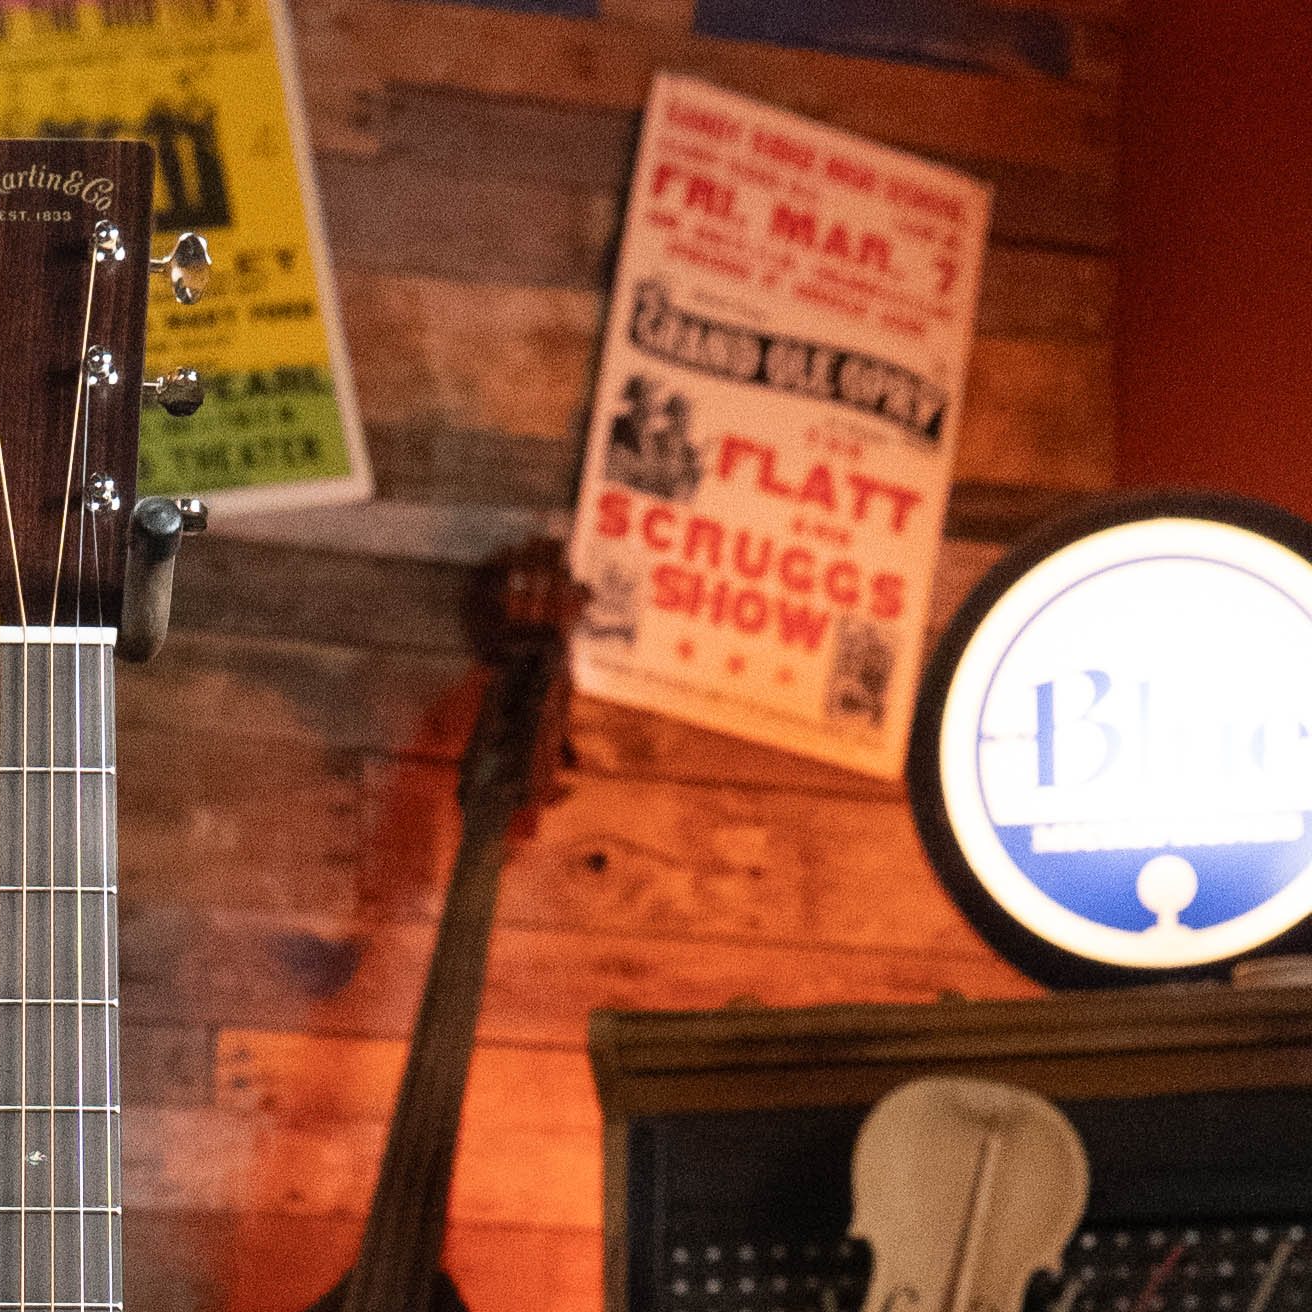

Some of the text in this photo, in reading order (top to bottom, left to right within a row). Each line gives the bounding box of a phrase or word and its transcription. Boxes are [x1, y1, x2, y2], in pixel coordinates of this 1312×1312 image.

[36, 210, 72, 222] 1833
[717, 434, 924, 535] FLATT
[596, 490, 906, 621] SCRUGGS
[651, 562, 832, 656] SHOW
[1034, 668, 1311, 789] Ble
